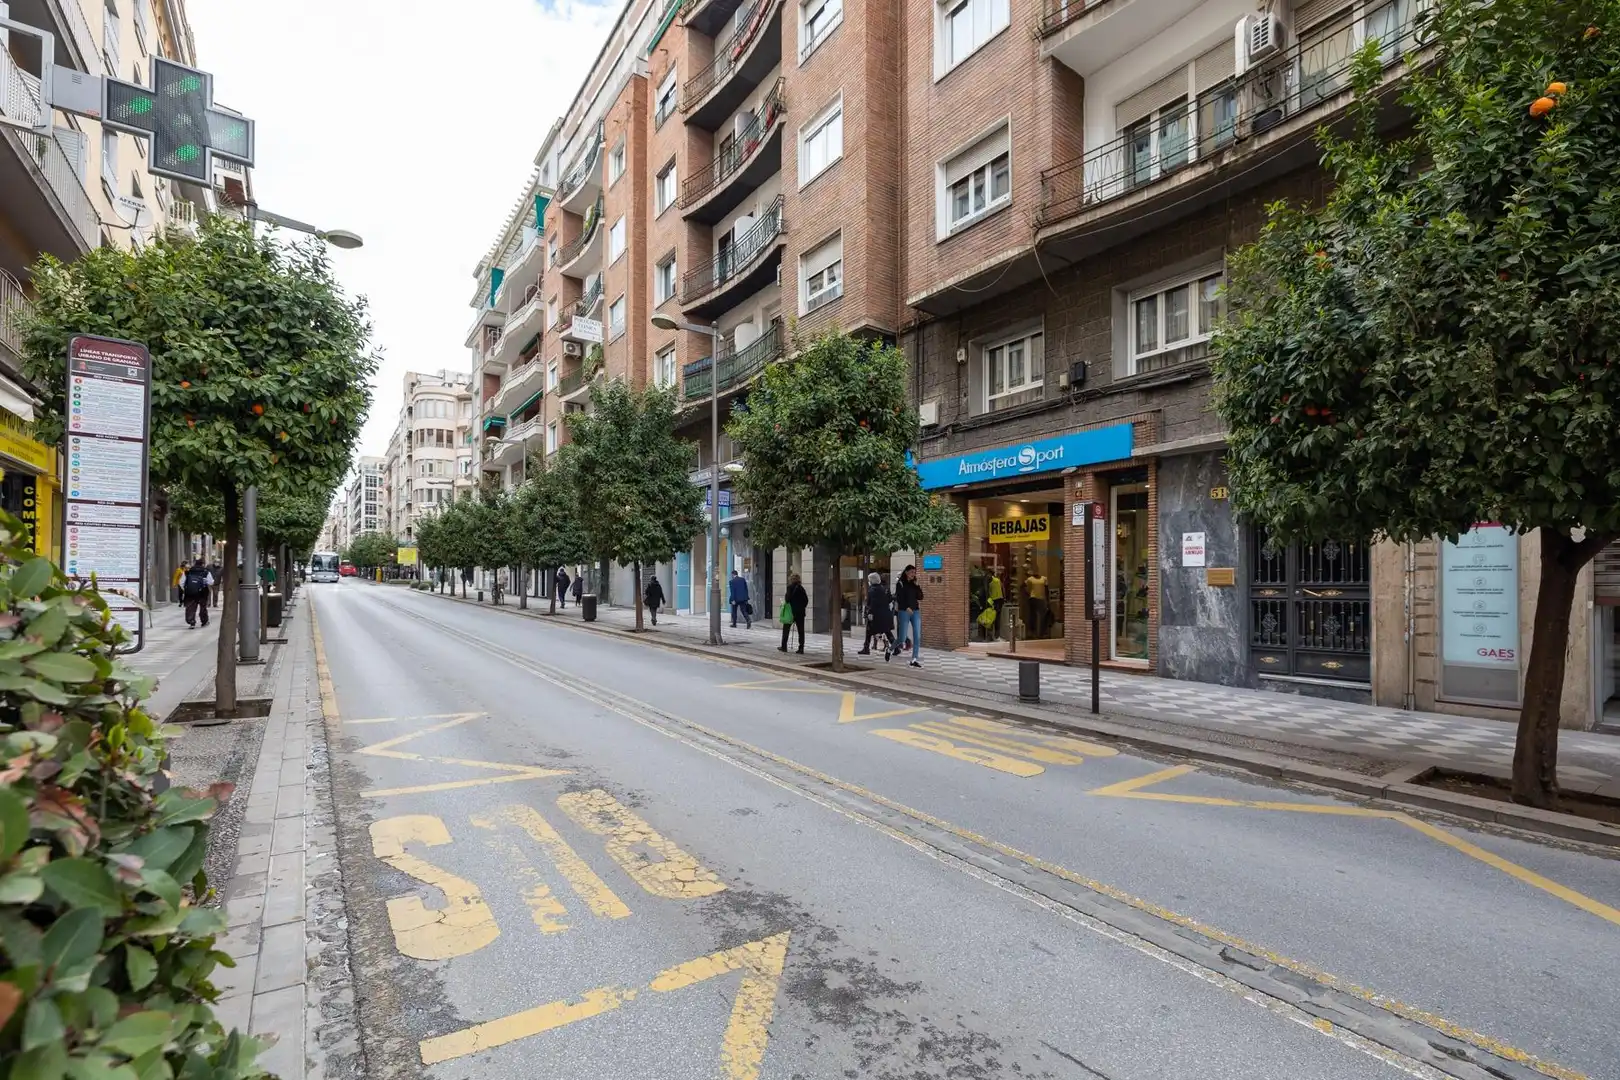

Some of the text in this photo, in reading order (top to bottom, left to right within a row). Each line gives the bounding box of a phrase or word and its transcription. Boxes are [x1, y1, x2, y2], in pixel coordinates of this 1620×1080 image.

[112, 358, 140, 366] GRANADA
[958, 456, 1017, 476] Atmósfera
[991, 517, 1047, 535] REBAJAS
[1477, 647, 1515, 658] GAES
